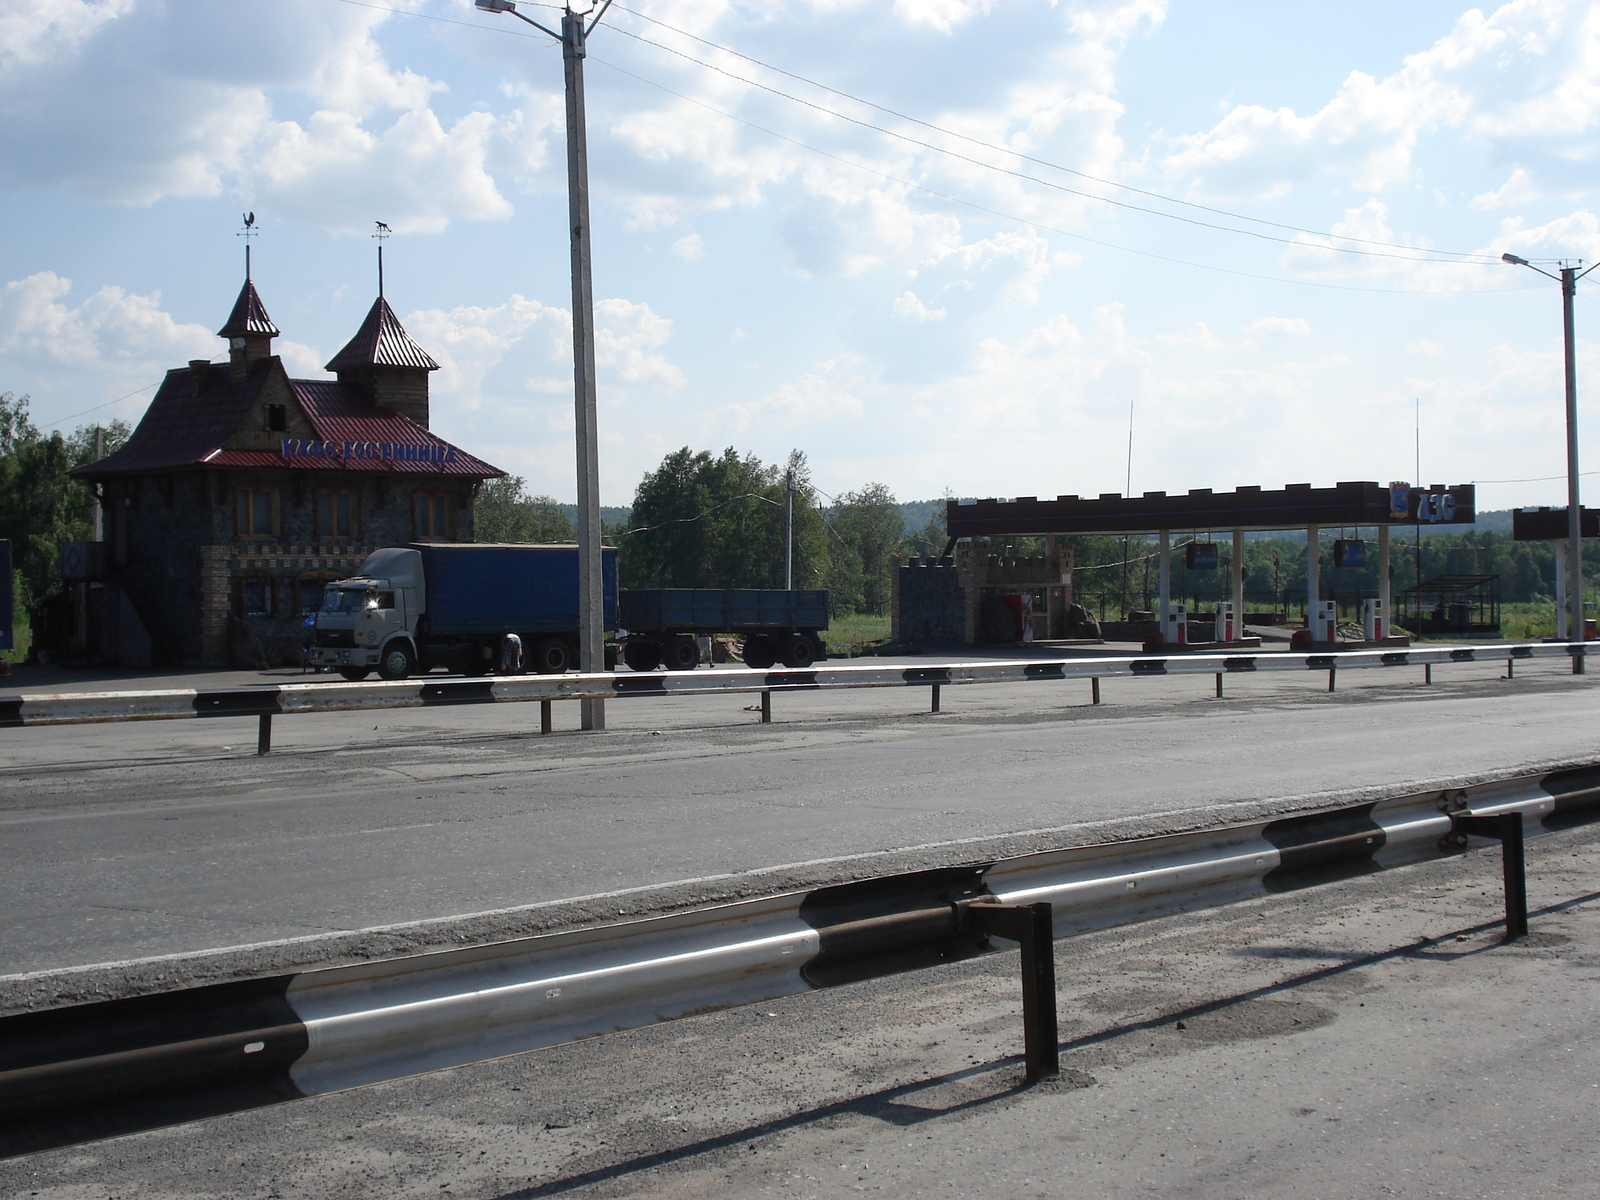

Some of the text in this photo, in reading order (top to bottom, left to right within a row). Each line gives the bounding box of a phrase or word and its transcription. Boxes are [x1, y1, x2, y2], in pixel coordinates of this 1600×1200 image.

[281, 439, 455, 463] КАФЕ ГОСТИНИЦА
[1417, 493, 1456, 522] АЗС
